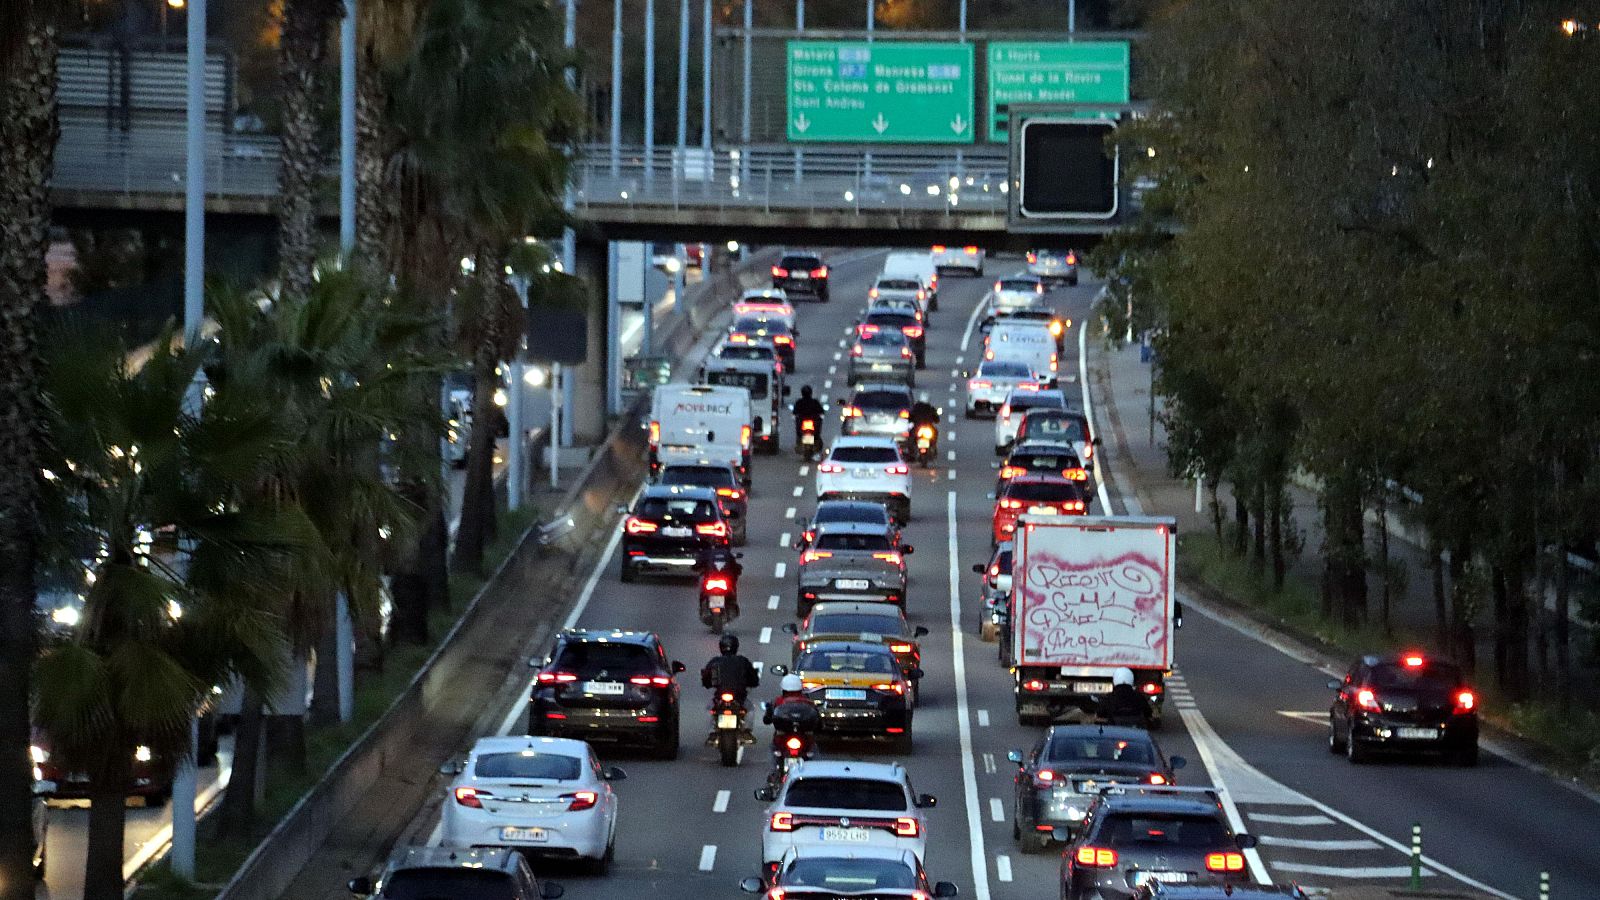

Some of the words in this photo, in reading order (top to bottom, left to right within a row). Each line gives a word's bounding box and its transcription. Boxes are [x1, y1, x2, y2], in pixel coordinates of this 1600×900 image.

[794, 63, 834, 77] Girona
[824, 79, 869, 93] Coloma
[874, 80, 890, 94] de
[826, 95, 866, 109] Andreu
